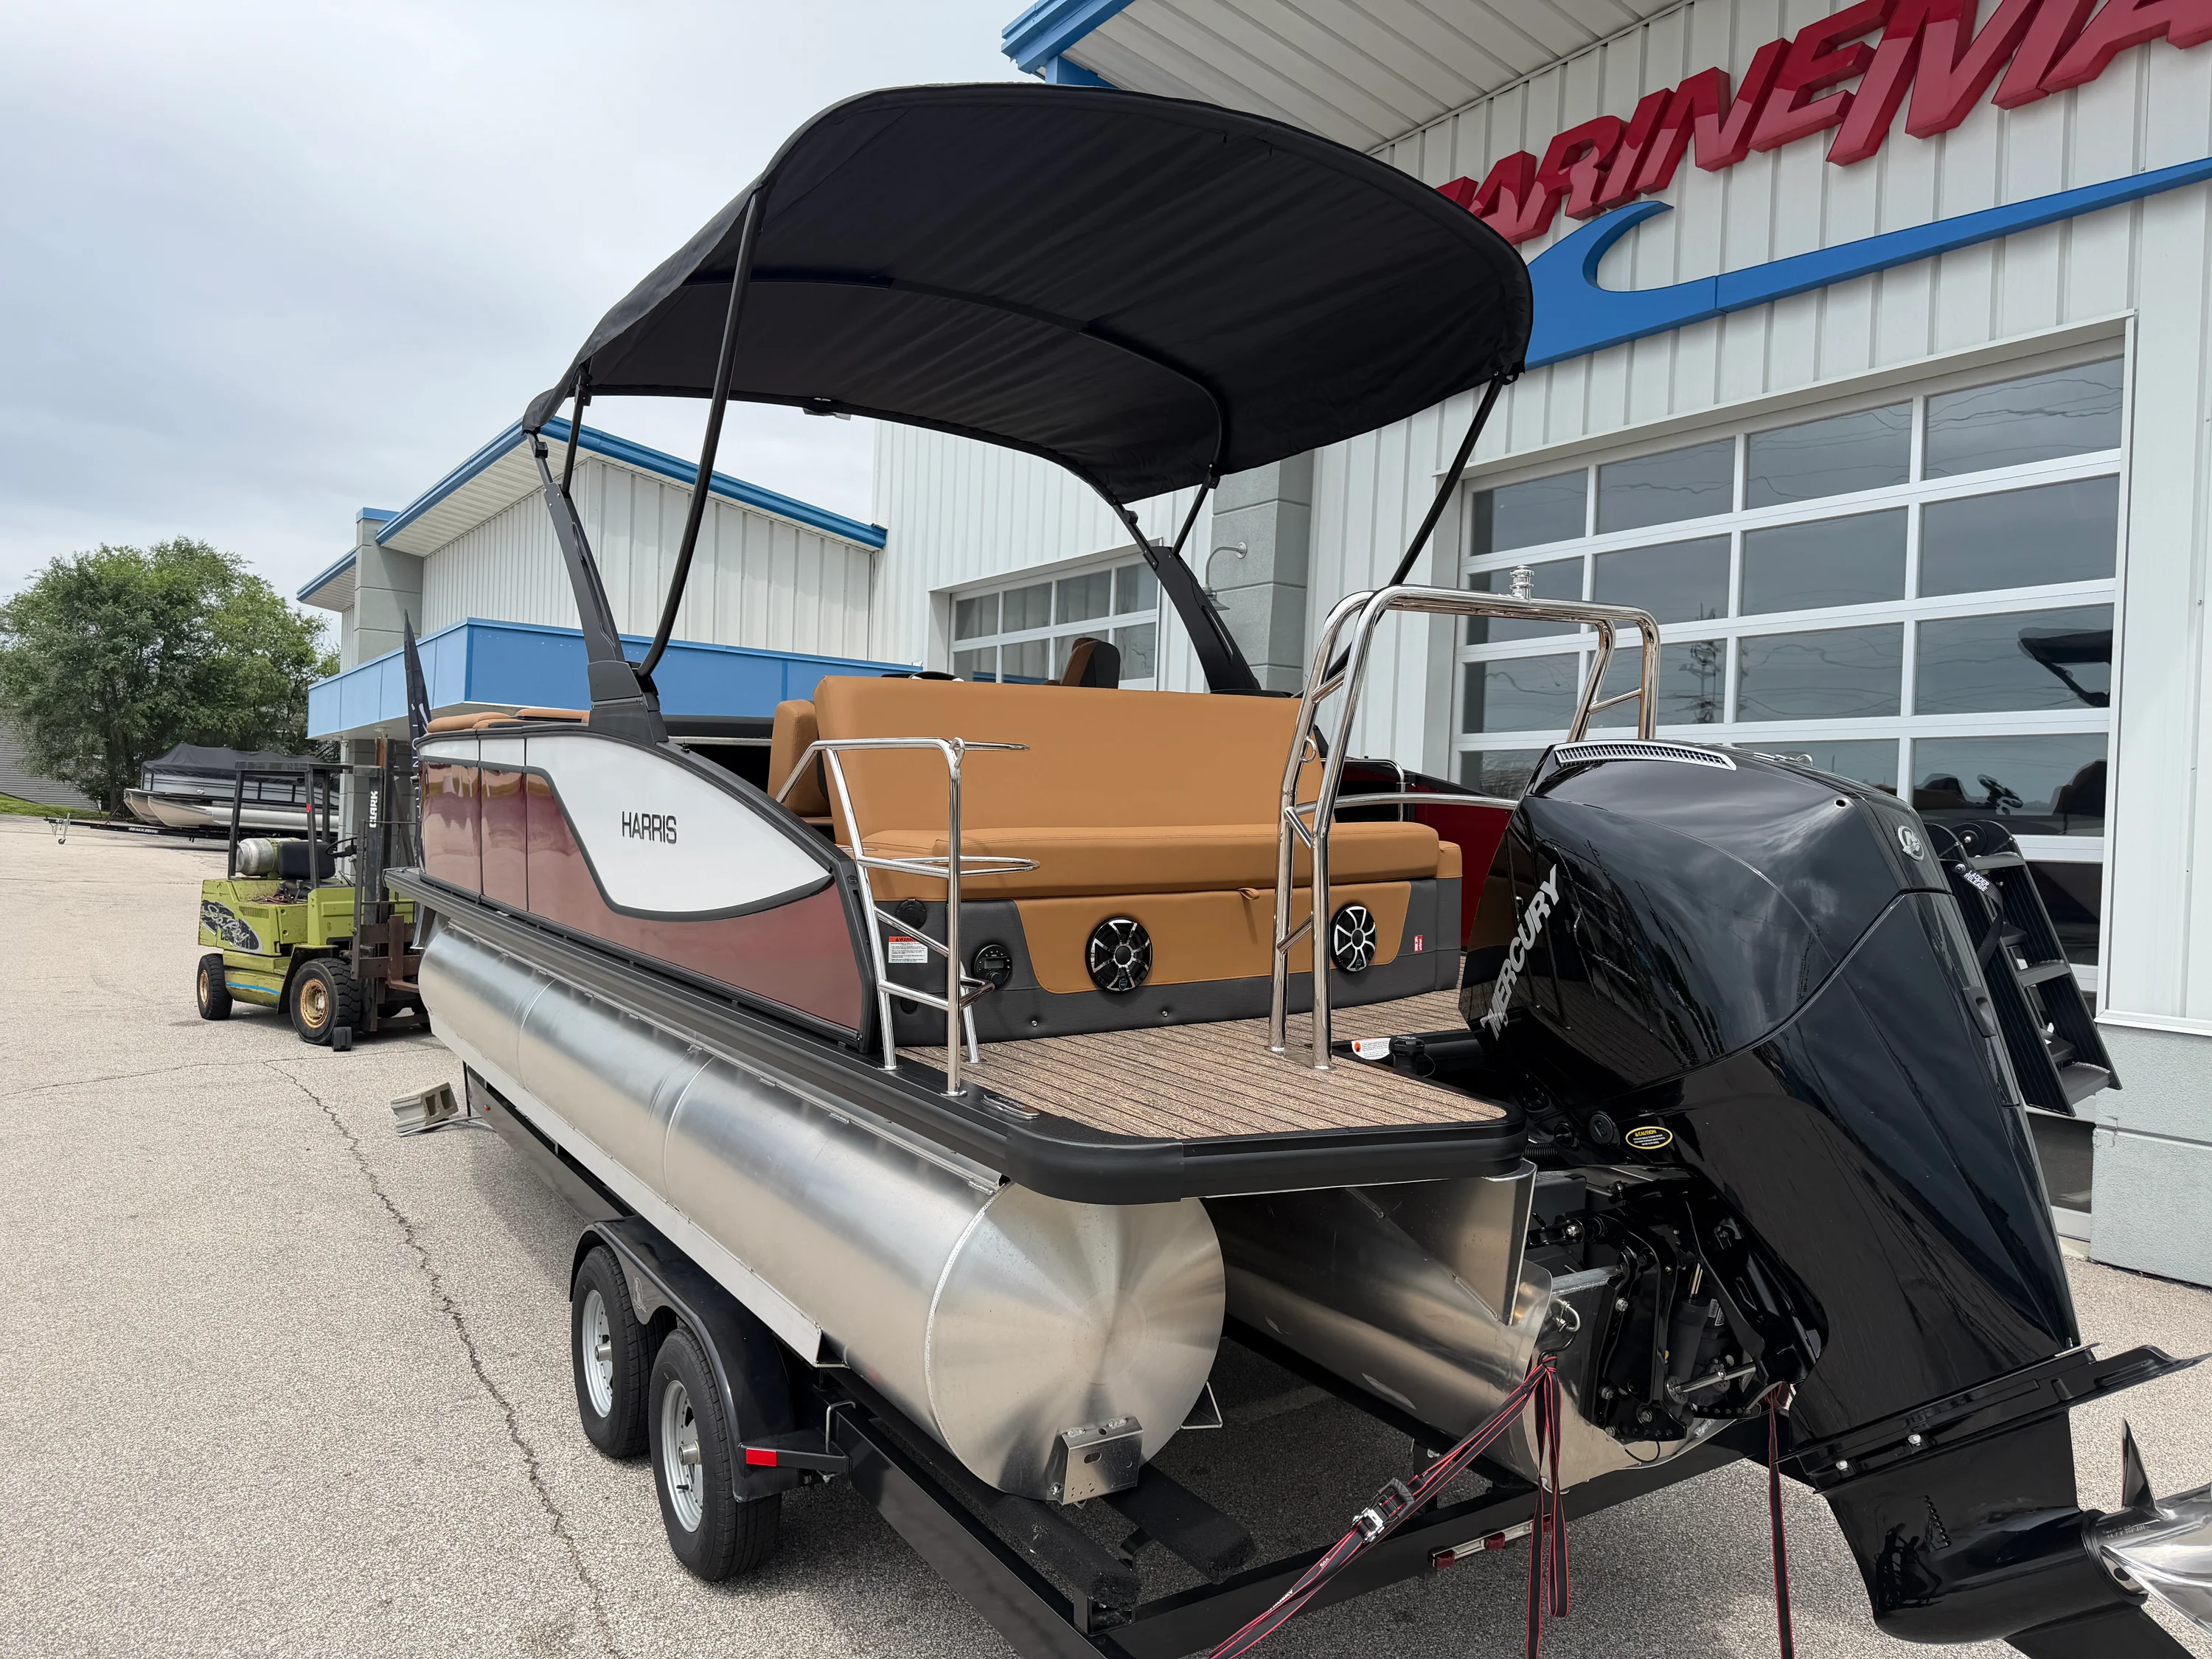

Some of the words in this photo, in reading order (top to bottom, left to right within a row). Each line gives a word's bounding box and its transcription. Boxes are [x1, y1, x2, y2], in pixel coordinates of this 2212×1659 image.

[369, 790, 378, 829] CLARK
[622, 811, 677, 844] HARRIS
[1964, 872, 1988, 892] RELEASE
[1969, 870, 1990, 887] LADDER
[1488, 863, 1559, 1041] MERCURY
